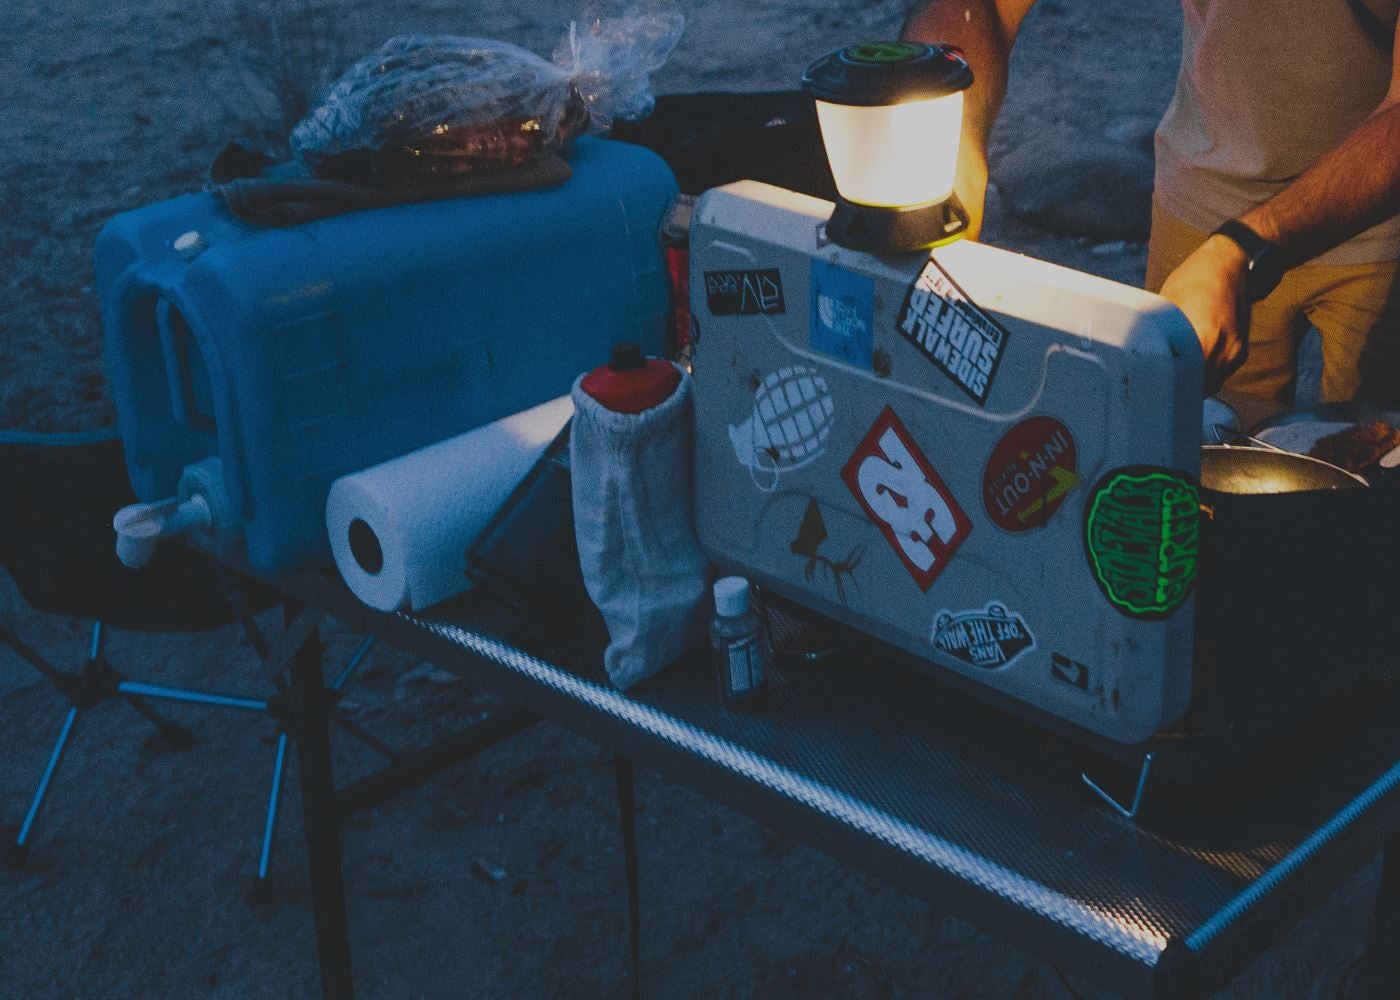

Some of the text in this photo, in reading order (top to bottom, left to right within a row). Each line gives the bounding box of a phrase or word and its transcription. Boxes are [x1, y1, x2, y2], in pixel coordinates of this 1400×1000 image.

[901, 306, 989, 398] SIDEWALK
[910, 286, 999, 373] SURFER
[1093, 481, 1161, 603] SIDEWALK
[969, 642, 1006, 665] VANS
